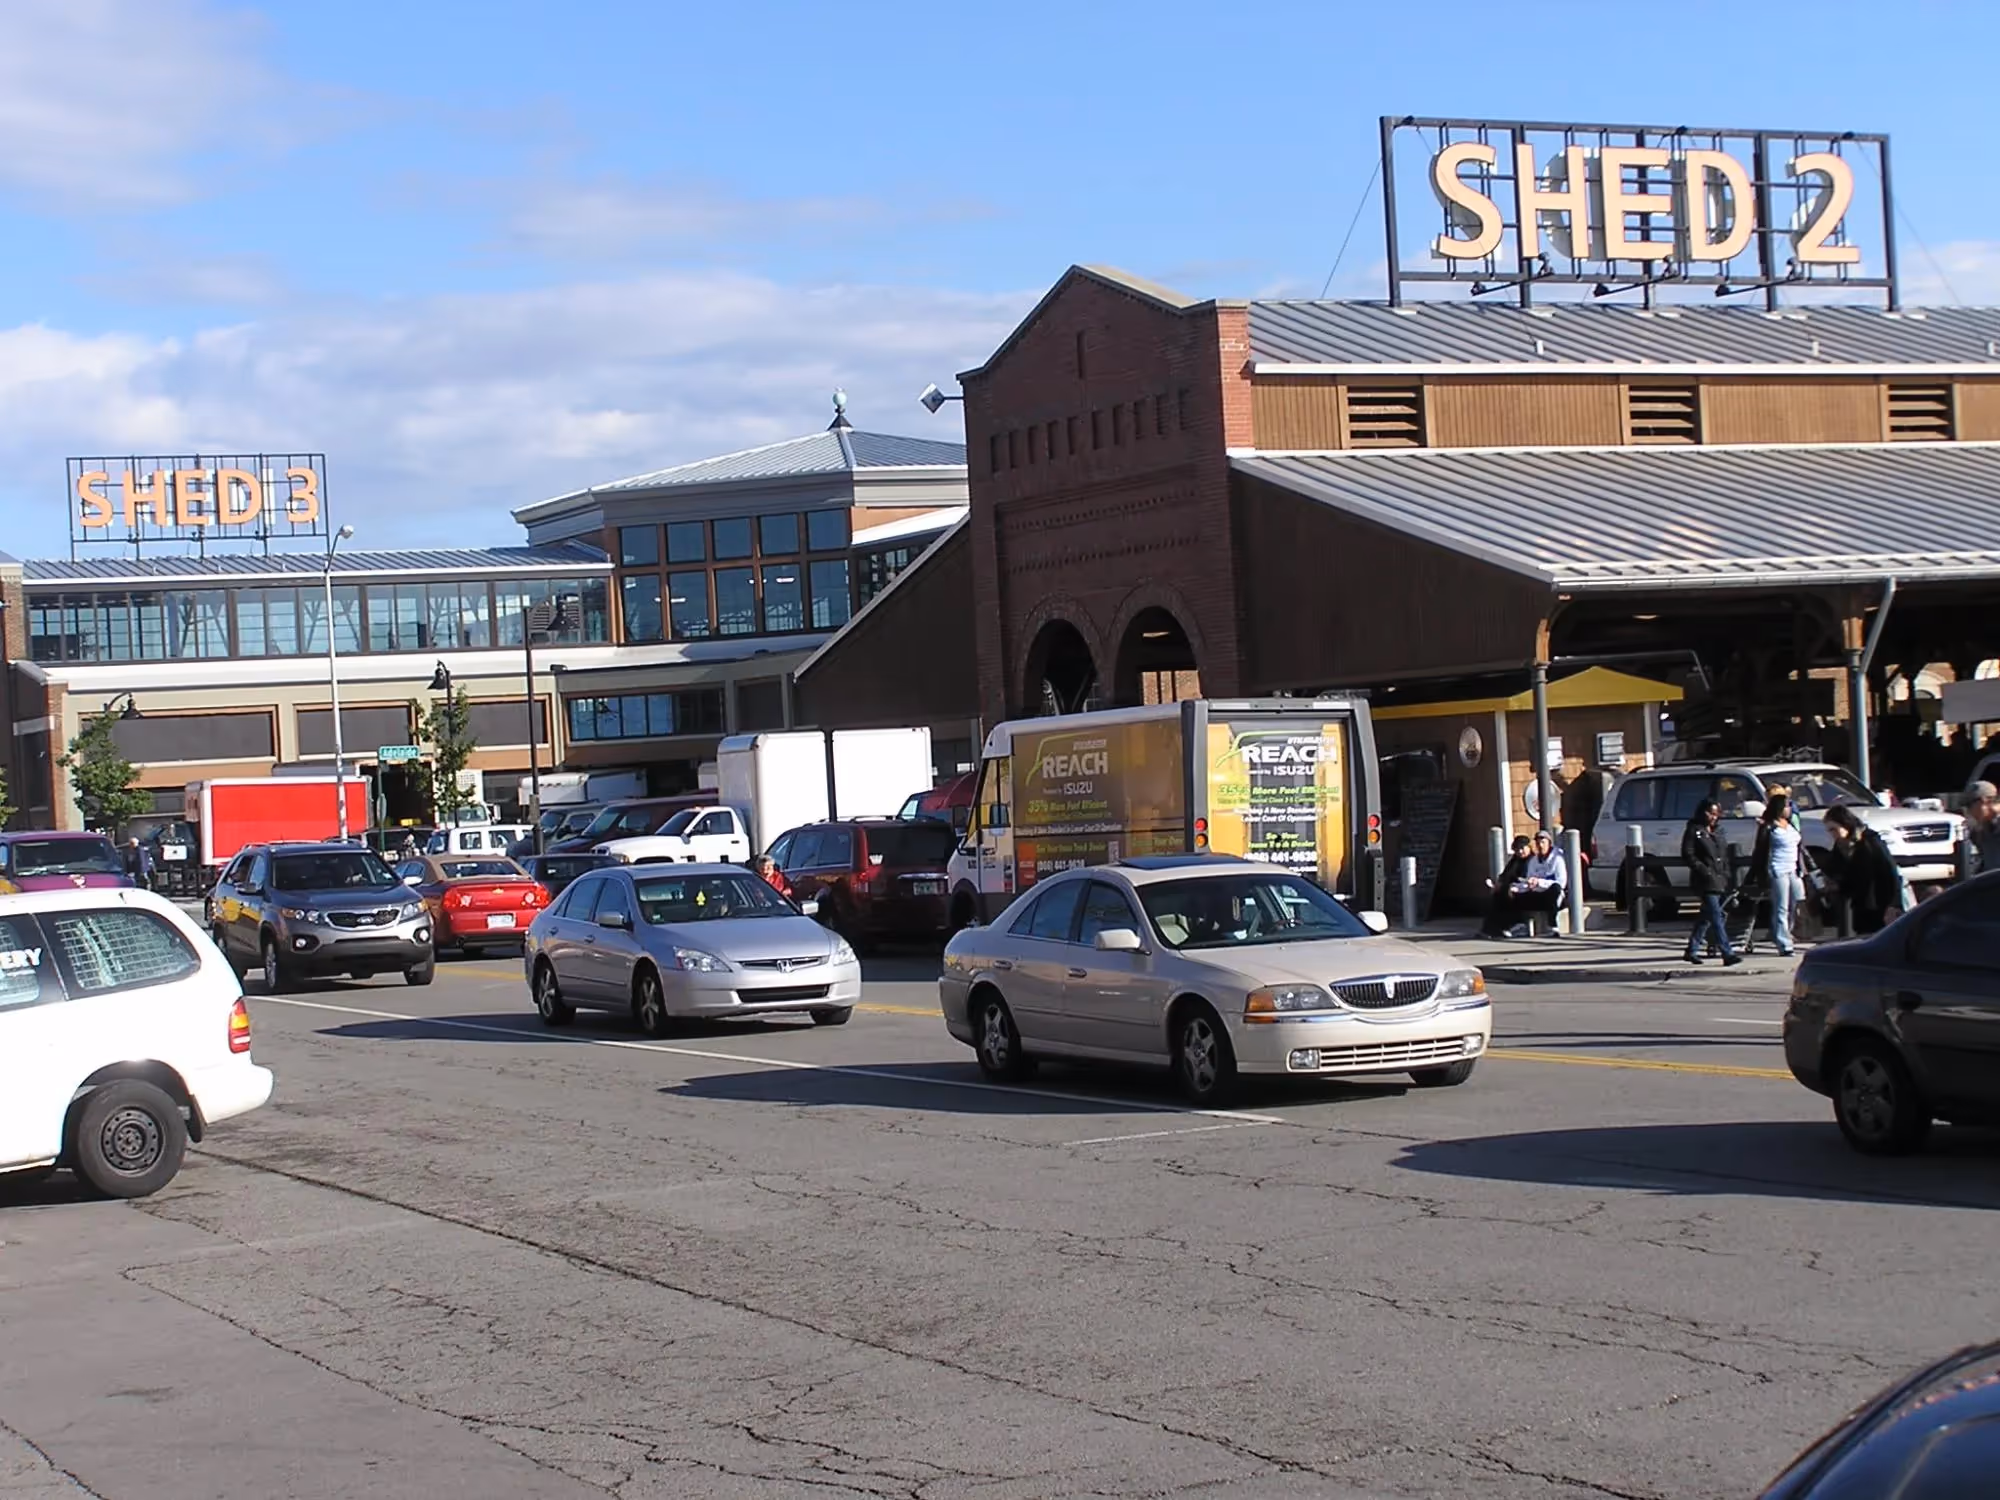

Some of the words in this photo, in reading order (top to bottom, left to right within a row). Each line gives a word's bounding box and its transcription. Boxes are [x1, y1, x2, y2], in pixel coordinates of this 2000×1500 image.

[1432, 141, 1754, 261] SHED
[1787, 152, 1861, 263] 2
[77, 468, 263, 528] SHED
[286, 467, 319, 524] 3
[1241, 745, 1337, 763] REACH
[1042, 752, 1109, 779] REACH
[1273, 765, 1315, 776] ISUZU
[1063, 781, 1094, 796] ISUZU
[1252, 785, 1277, 795] More
[1279, 785, 1300, 795] Fuel
[1028, 800, 1049, 813] 35%
